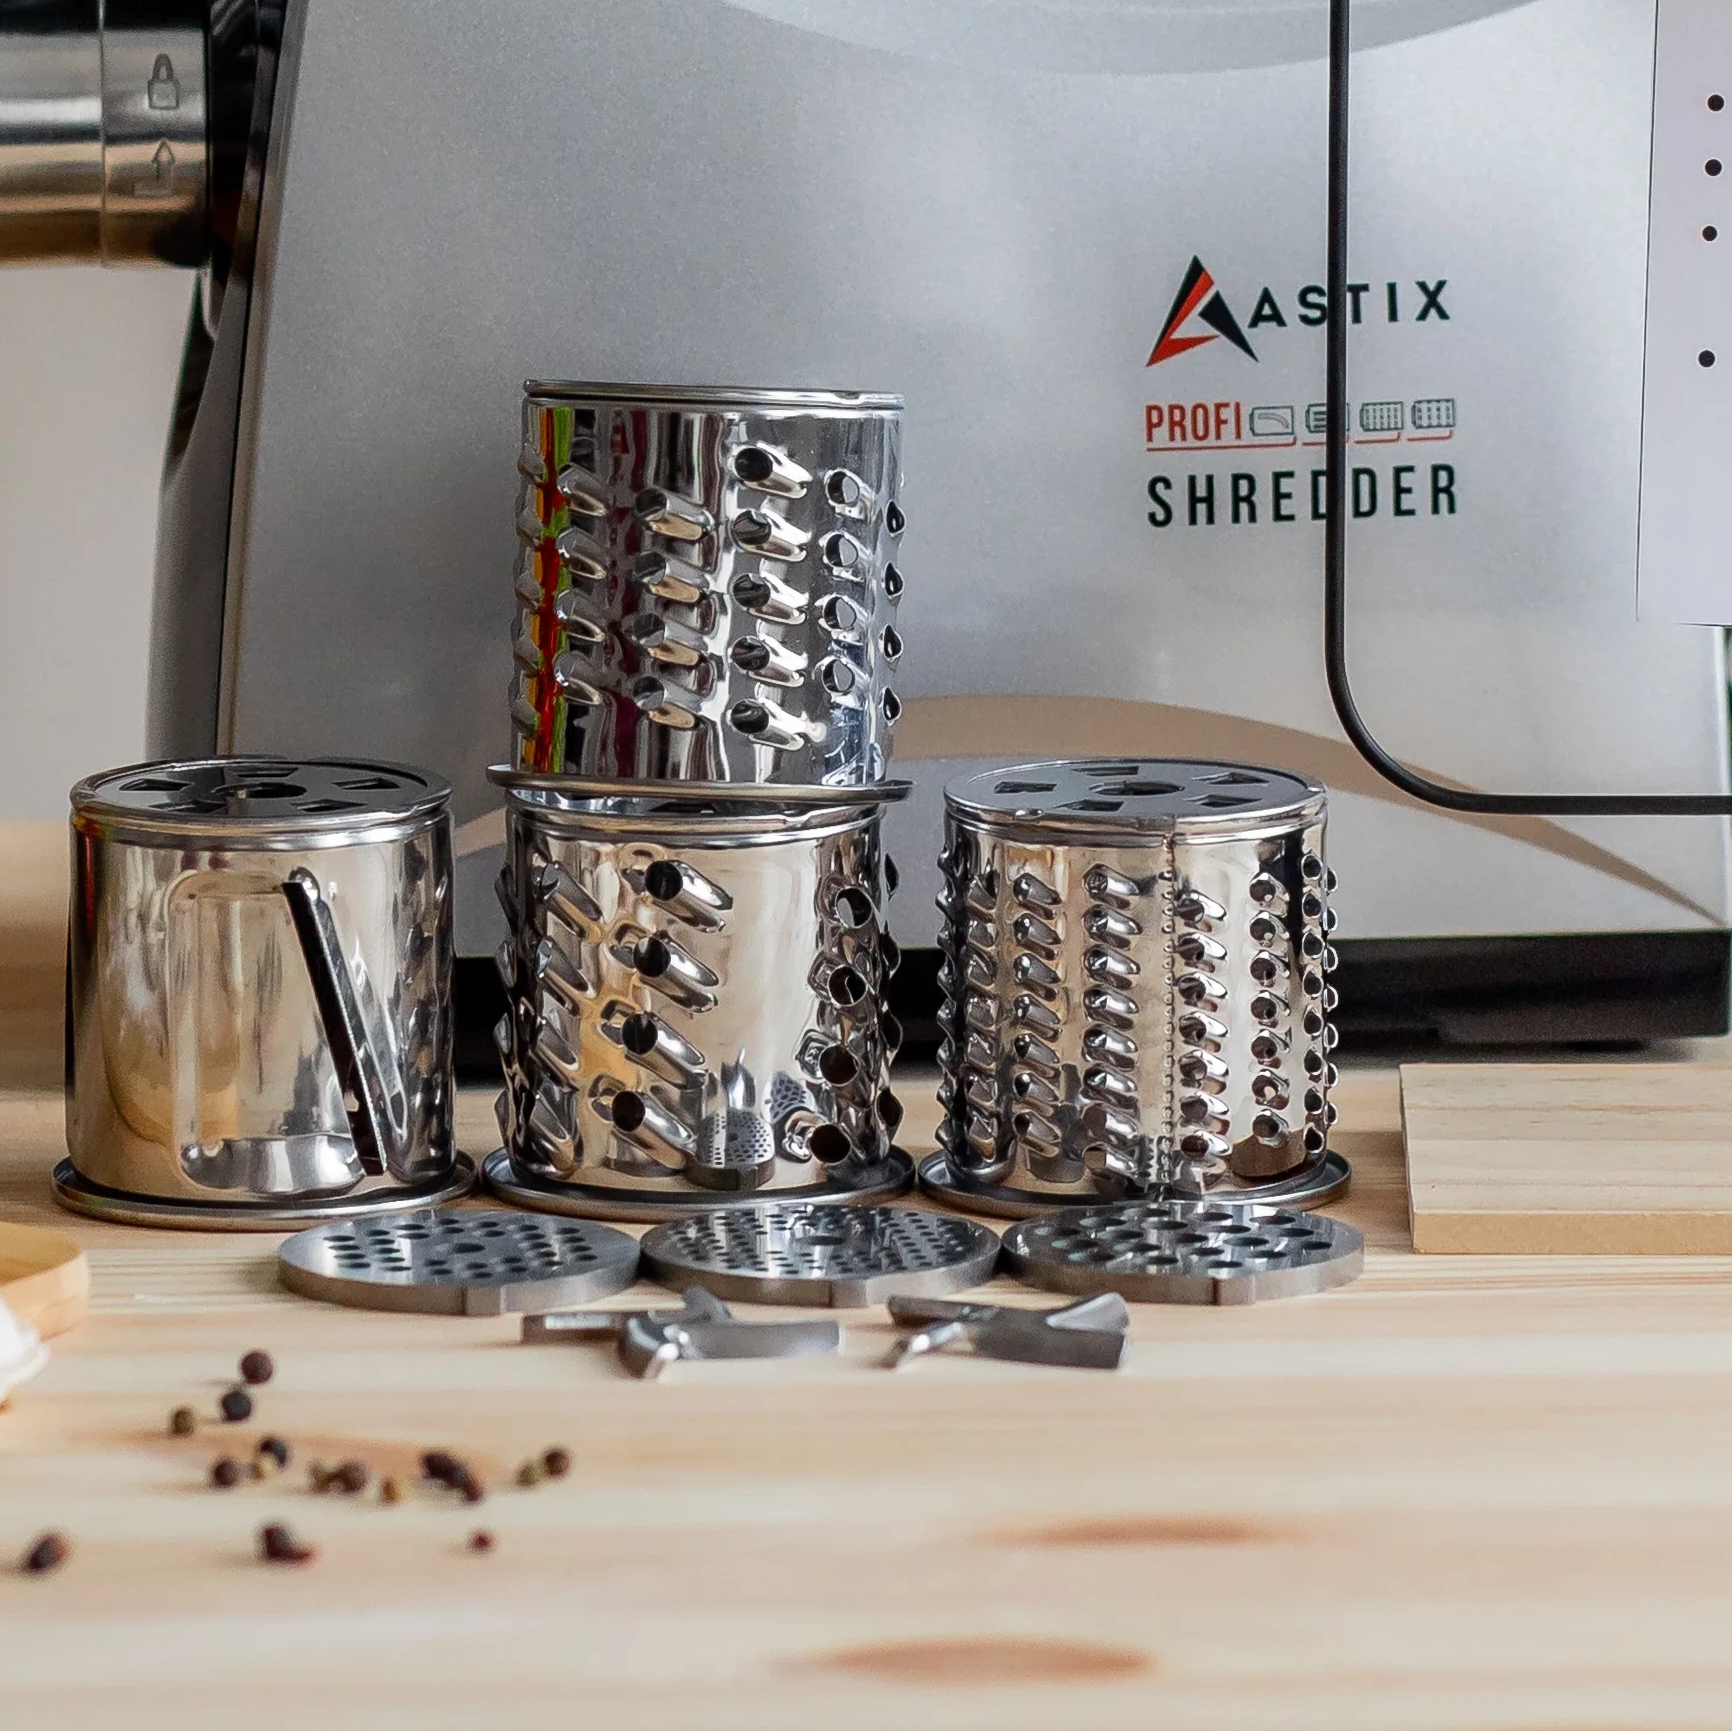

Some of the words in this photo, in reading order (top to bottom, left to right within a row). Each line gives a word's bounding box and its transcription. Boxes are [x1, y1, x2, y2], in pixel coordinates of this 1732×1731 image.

[1247, 278, 1451, 329] ASTIX
[1145, 401, 1243, 442] PROFI
[1146, 463, 1457, 528] SHREDDER
